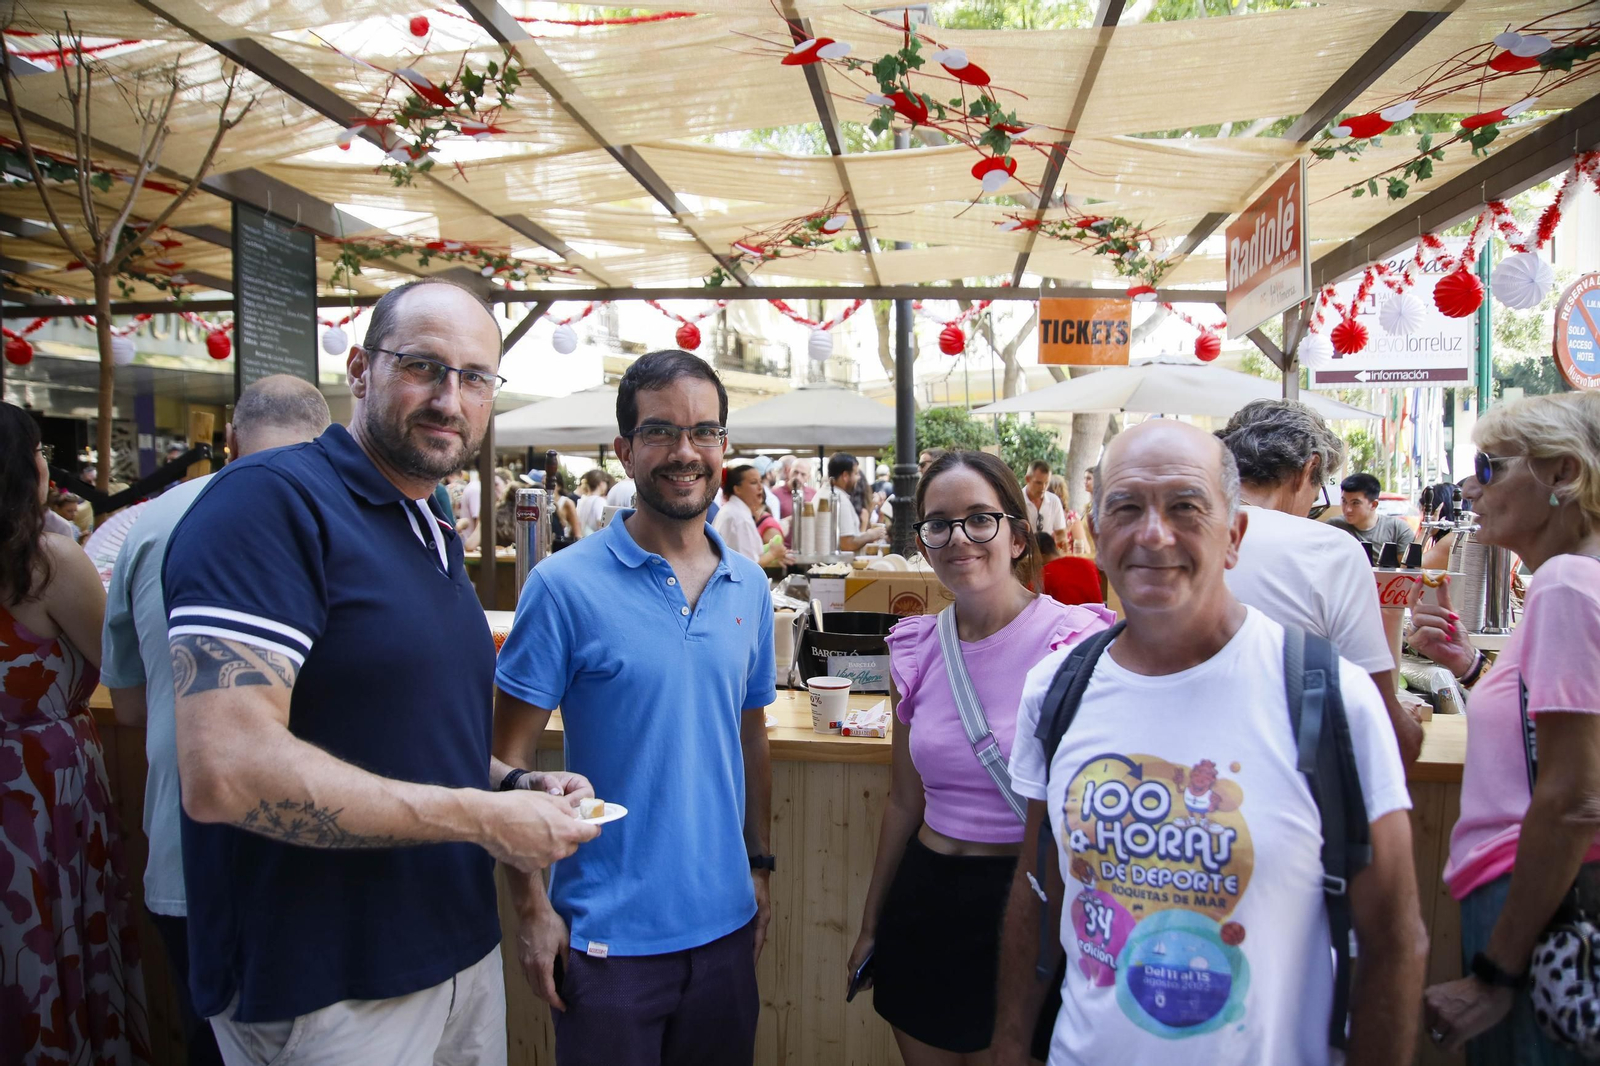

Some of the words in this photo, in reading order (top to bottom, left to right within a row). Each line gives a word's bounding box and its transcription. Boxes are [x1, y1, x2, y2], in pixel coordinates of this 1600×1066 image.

[1229, 182, 1296, 292] Radiolé
[1561, 276, 1596, 321] RESERVA
[1041, 319, 1129, 345] TICKETS
[1568, 325, 1586, 336] SOLO
[1568, 339, 1593, 350] ACCESO
[1576, 351, 1595, 362] HOTEL
[1370, 370, 1429, 381] información
[848, 661, 877, 669] BARCELÓ
[1081, 779, 1171, 825] 100
[1095, 820, 1237, 873] HORAS
[1101, 861, 1127, 882] DE
[1131, 864, 1239, 896] DEPORTE
[1112, 884, 1169, 903] ROQUETAS
[1173, 895, 1189, 905] DE
[1194, 896, 1226, 908] MAR
[1083, 900, 1114, 945] 34
[1077, 938, 1118, 971] edición
[1143, 977, 1180, 989] agosto
[1144, 965, 1165, 979] Del
[1167, 968, 1177, 980] 11
[1180, 970, 1193, 981] al
[1196, 971, 1211, 983] 15
